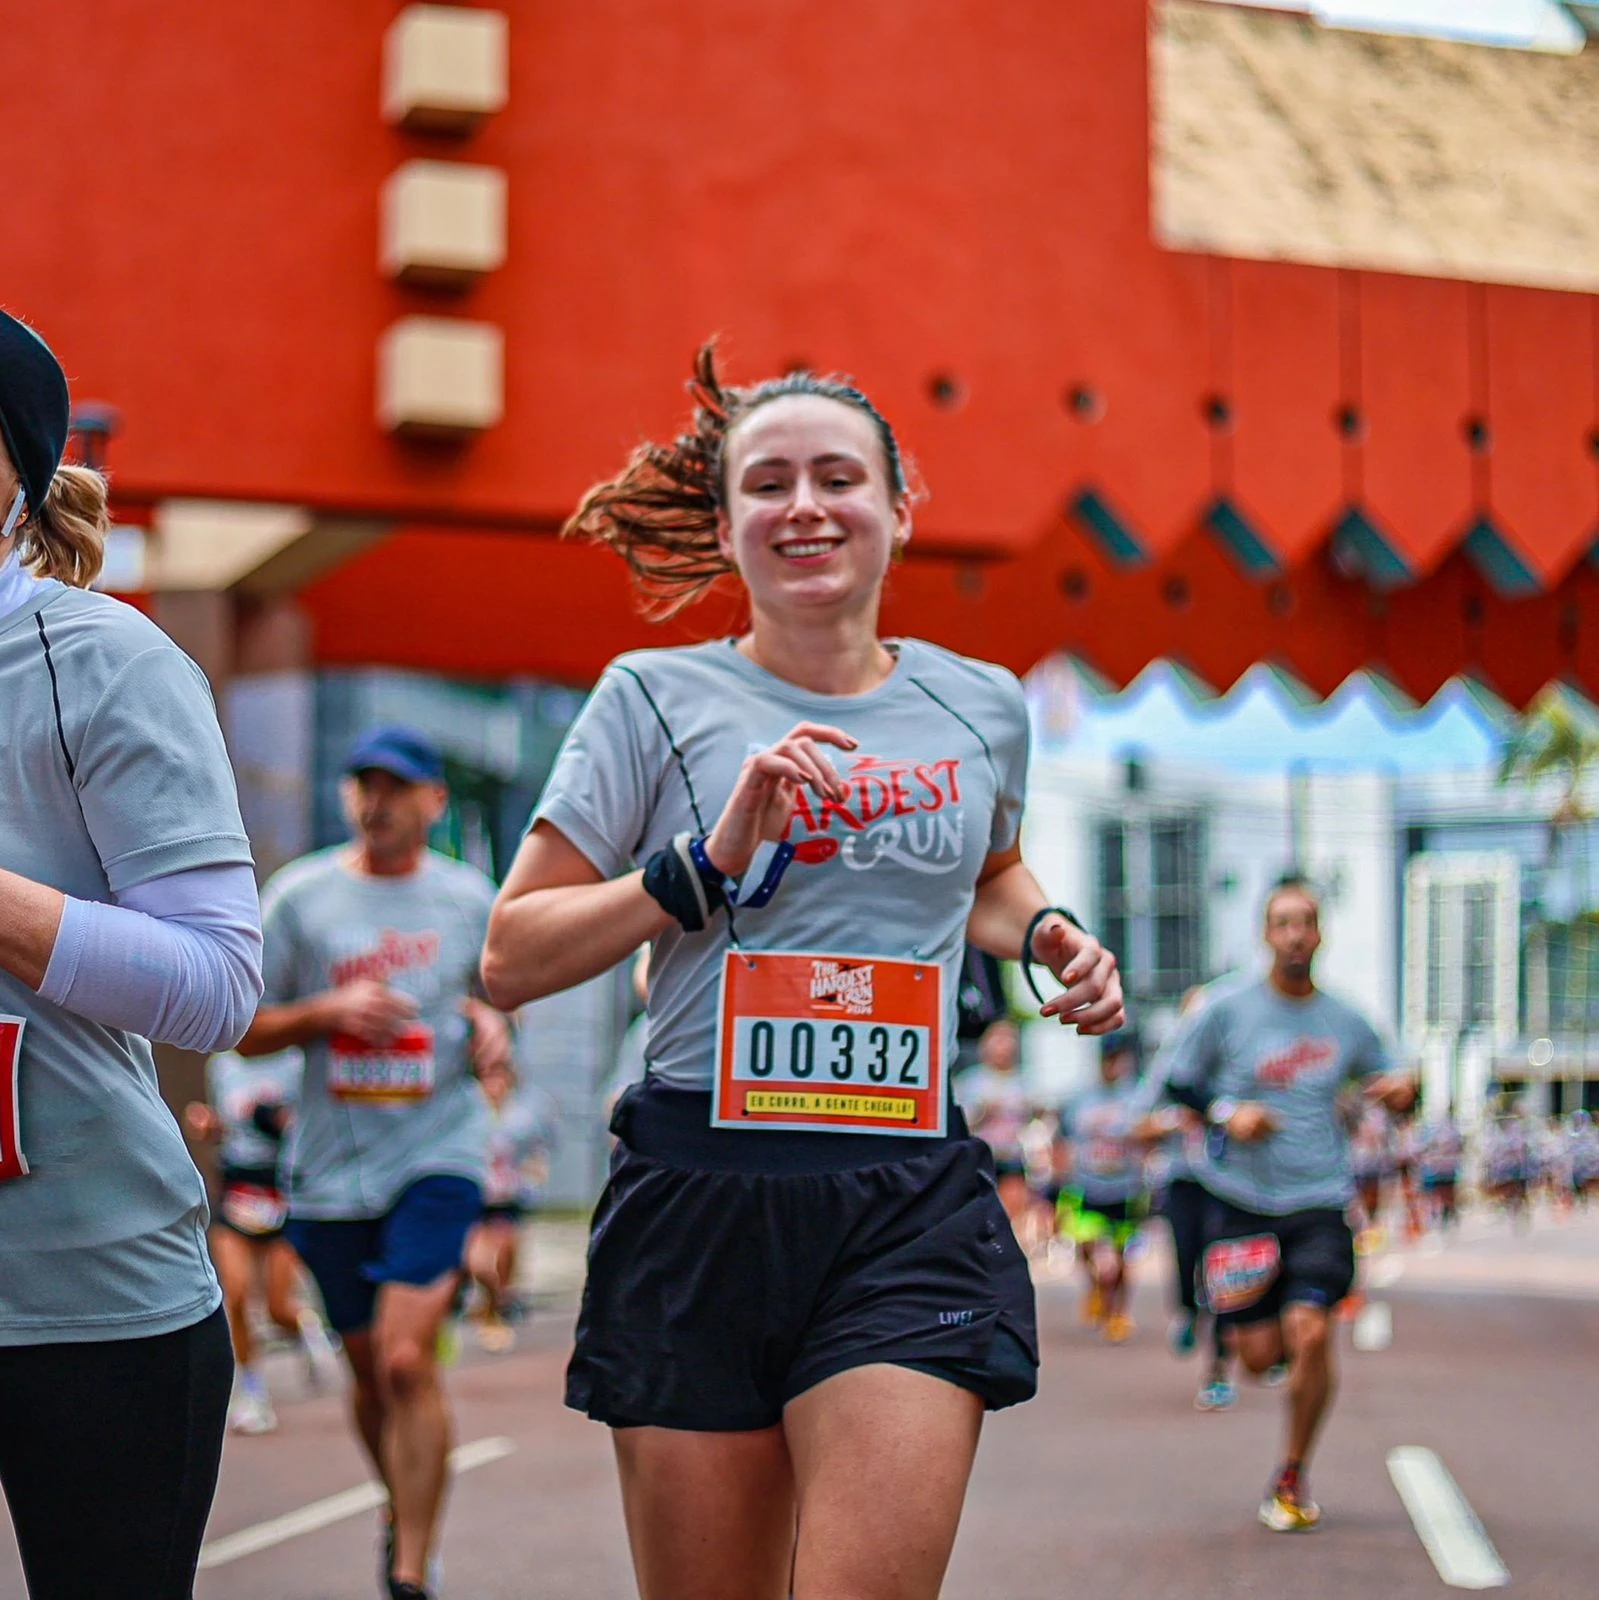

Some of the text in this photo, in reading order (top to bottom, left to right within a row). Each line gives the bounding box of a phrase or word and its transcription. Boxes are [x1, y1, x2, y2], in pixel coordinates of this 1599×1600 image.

[780, 758, 961, 841] ARDEST
[839, 809, 964, 875] RUN
[810, 965, 874, 999] HARDEST
[811, 960, 839, 978] THE
[750, 1021, 919, 1085] 00332
[750, 1095, 764, 1108] EU
[815, 1097, 821, 1108] A
[826, 1098, 859, 1111] GENTE
